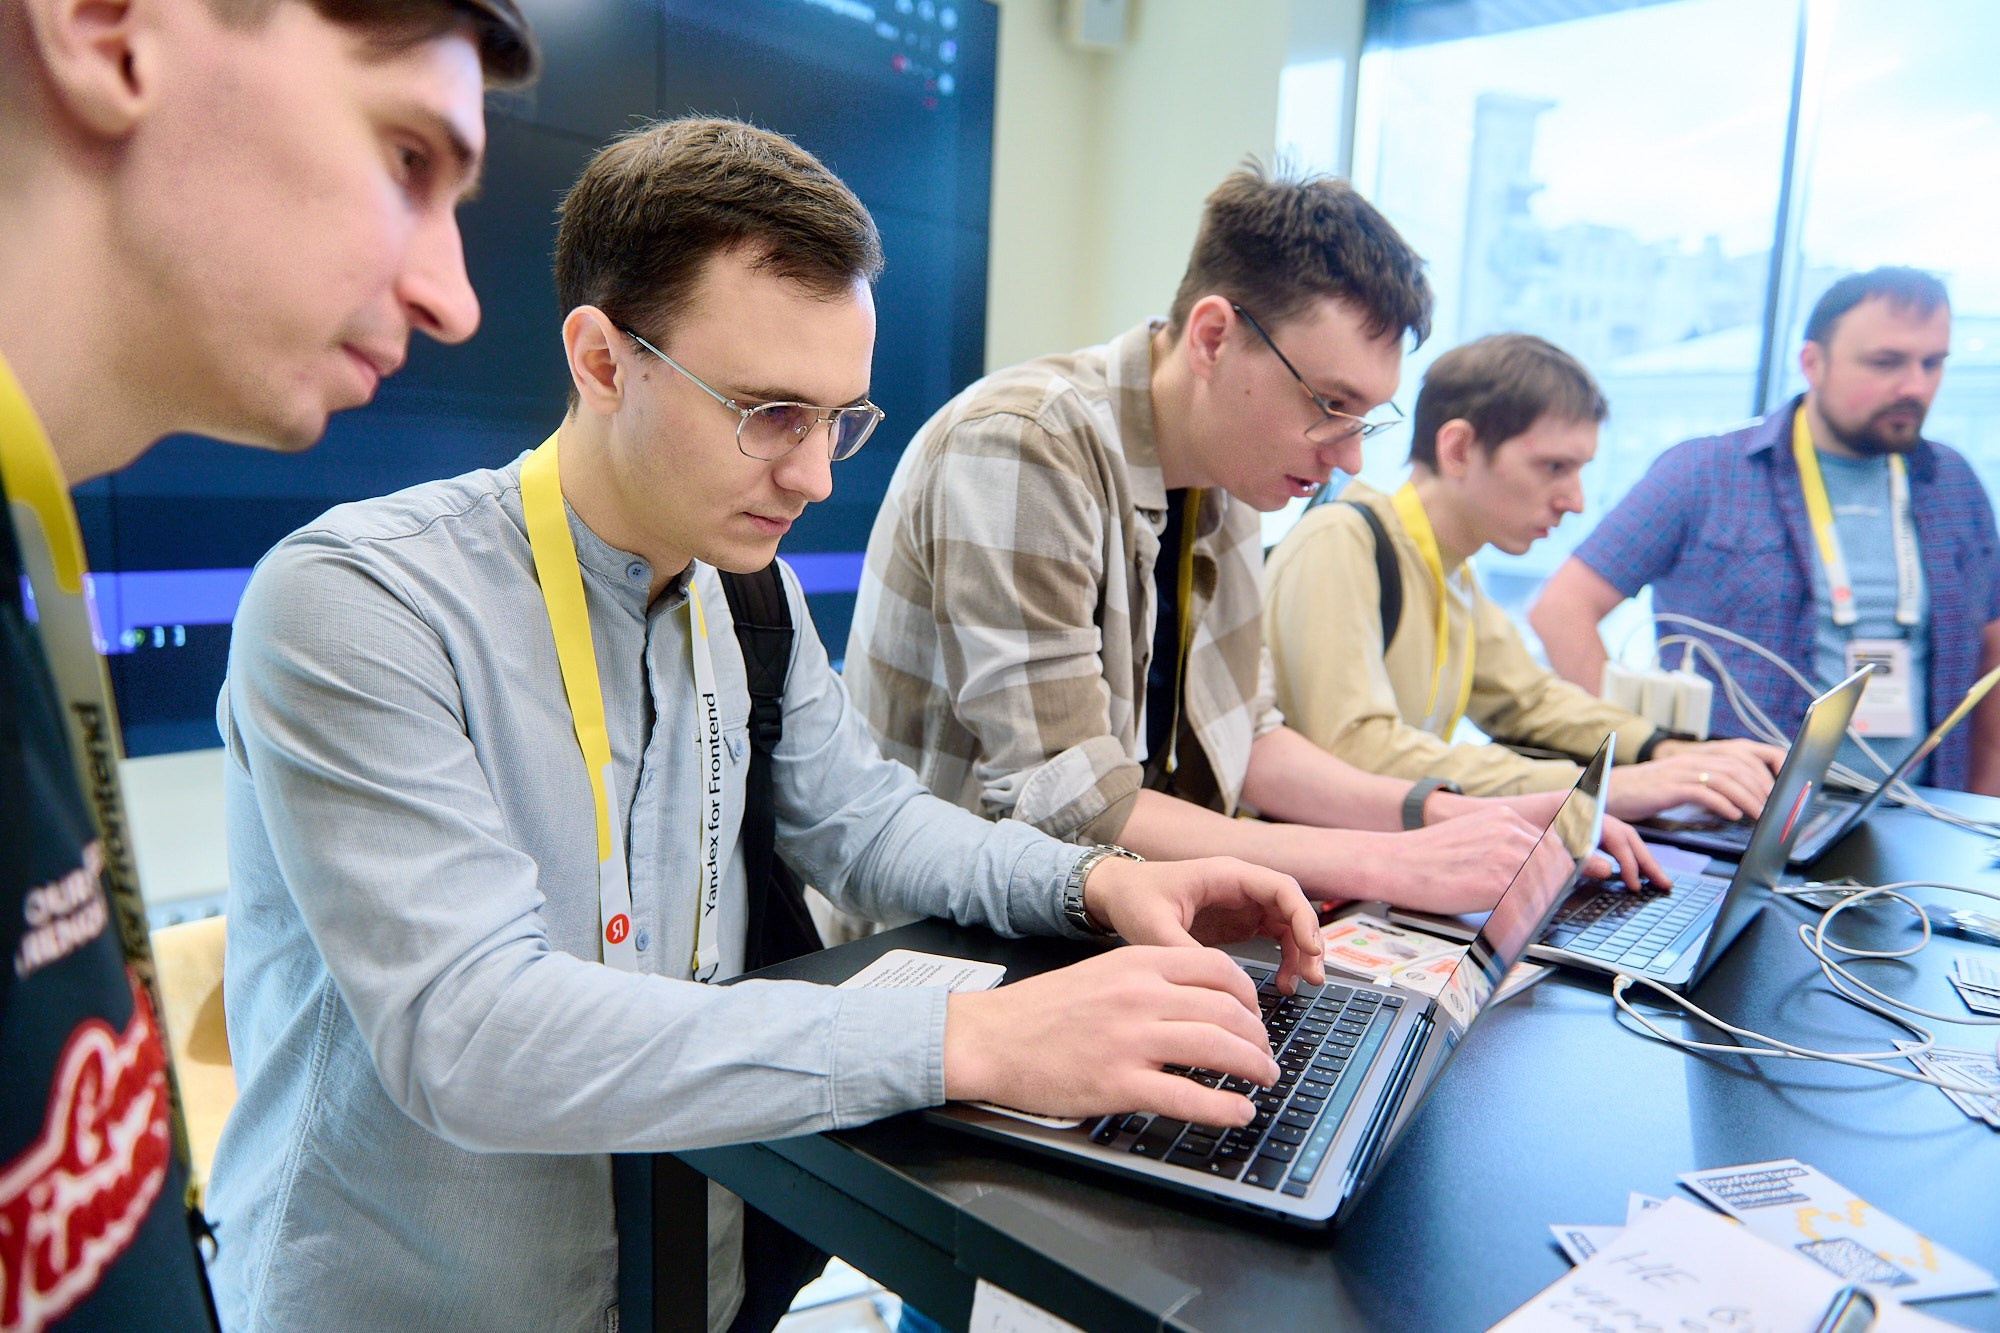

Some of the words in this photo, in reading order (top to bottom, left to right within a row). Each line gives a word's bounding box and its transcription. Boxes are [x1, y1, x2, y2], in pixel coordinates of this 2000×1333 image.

[702, 693, 721, 796] Frontend
[708, 799, 721, 832] for
[704, 834, 720, 918] Yandex
[611, 918, 624, 940] Я
